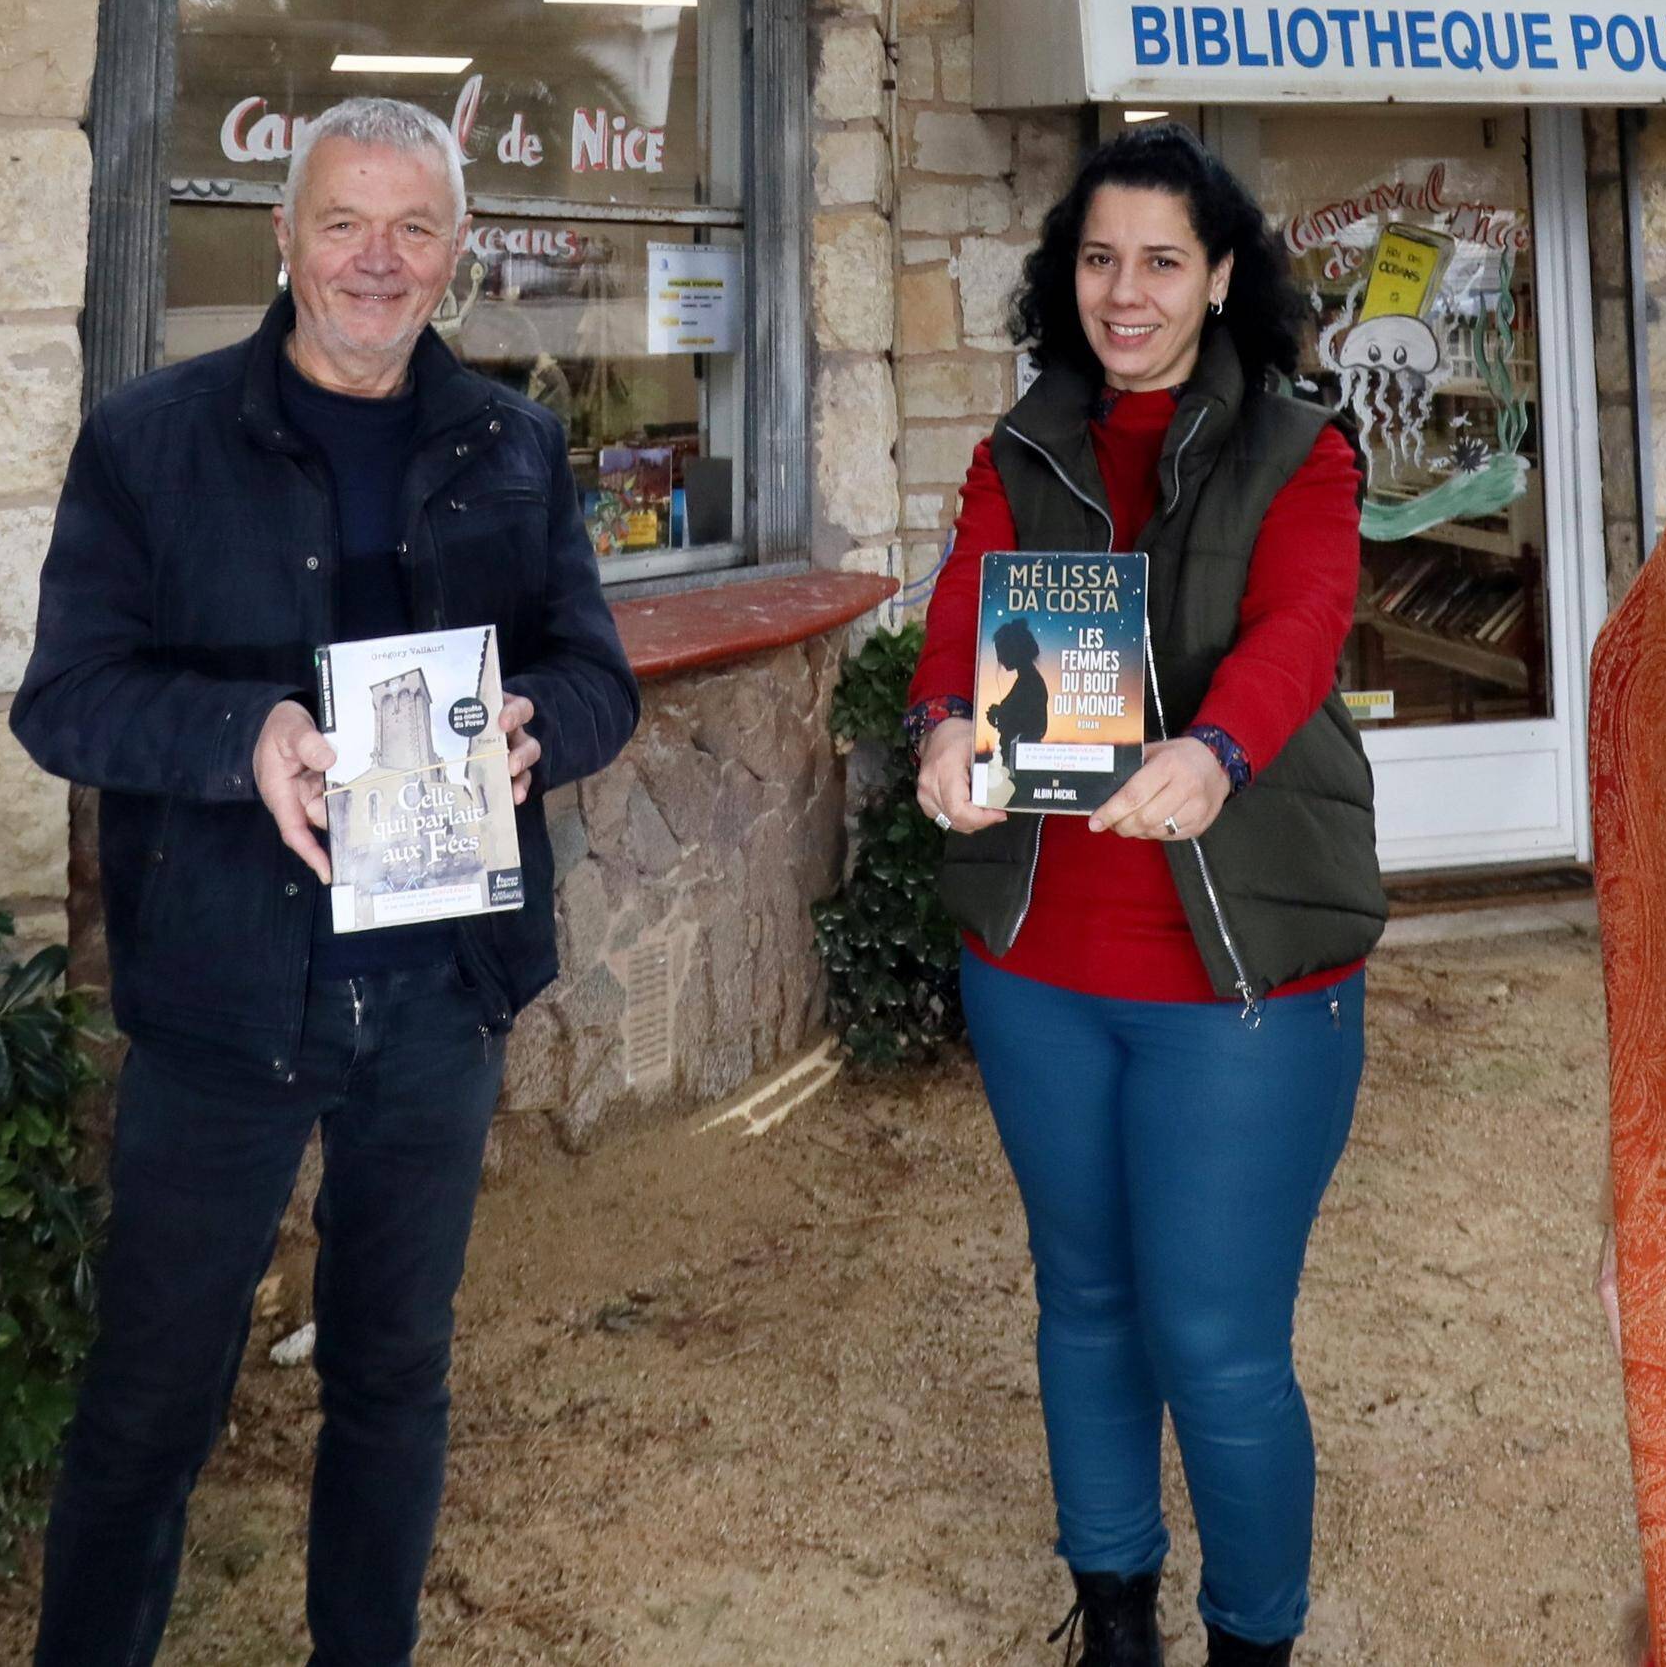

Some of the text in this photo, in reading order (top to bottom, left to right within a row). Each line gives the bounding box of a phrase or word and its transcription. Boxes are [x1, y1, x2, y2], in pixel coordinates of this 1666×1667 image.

[1131, 5, 1558, 73] BIBLIOTHEQUE
[497, 112, 544, 167] de
[1009, 558, 1119, 588] MÉLISSA
[1008, 588, 1119, 613] DA COSTA
[1078, 627, 1104, 649] LES
[1061, 649, 1120, 672] FEMMES
[1061, 672, 1120, 694] DU BOUT
[1053, 694, 1125, 717] DU MONDE
[397, 777, 456, 813] Celle
[1033, 787, 1078, 801] ALBIN MICHEL
[373, 805, 489, 839] qui parlait
[382, 827, 480, 867] aux Fées
